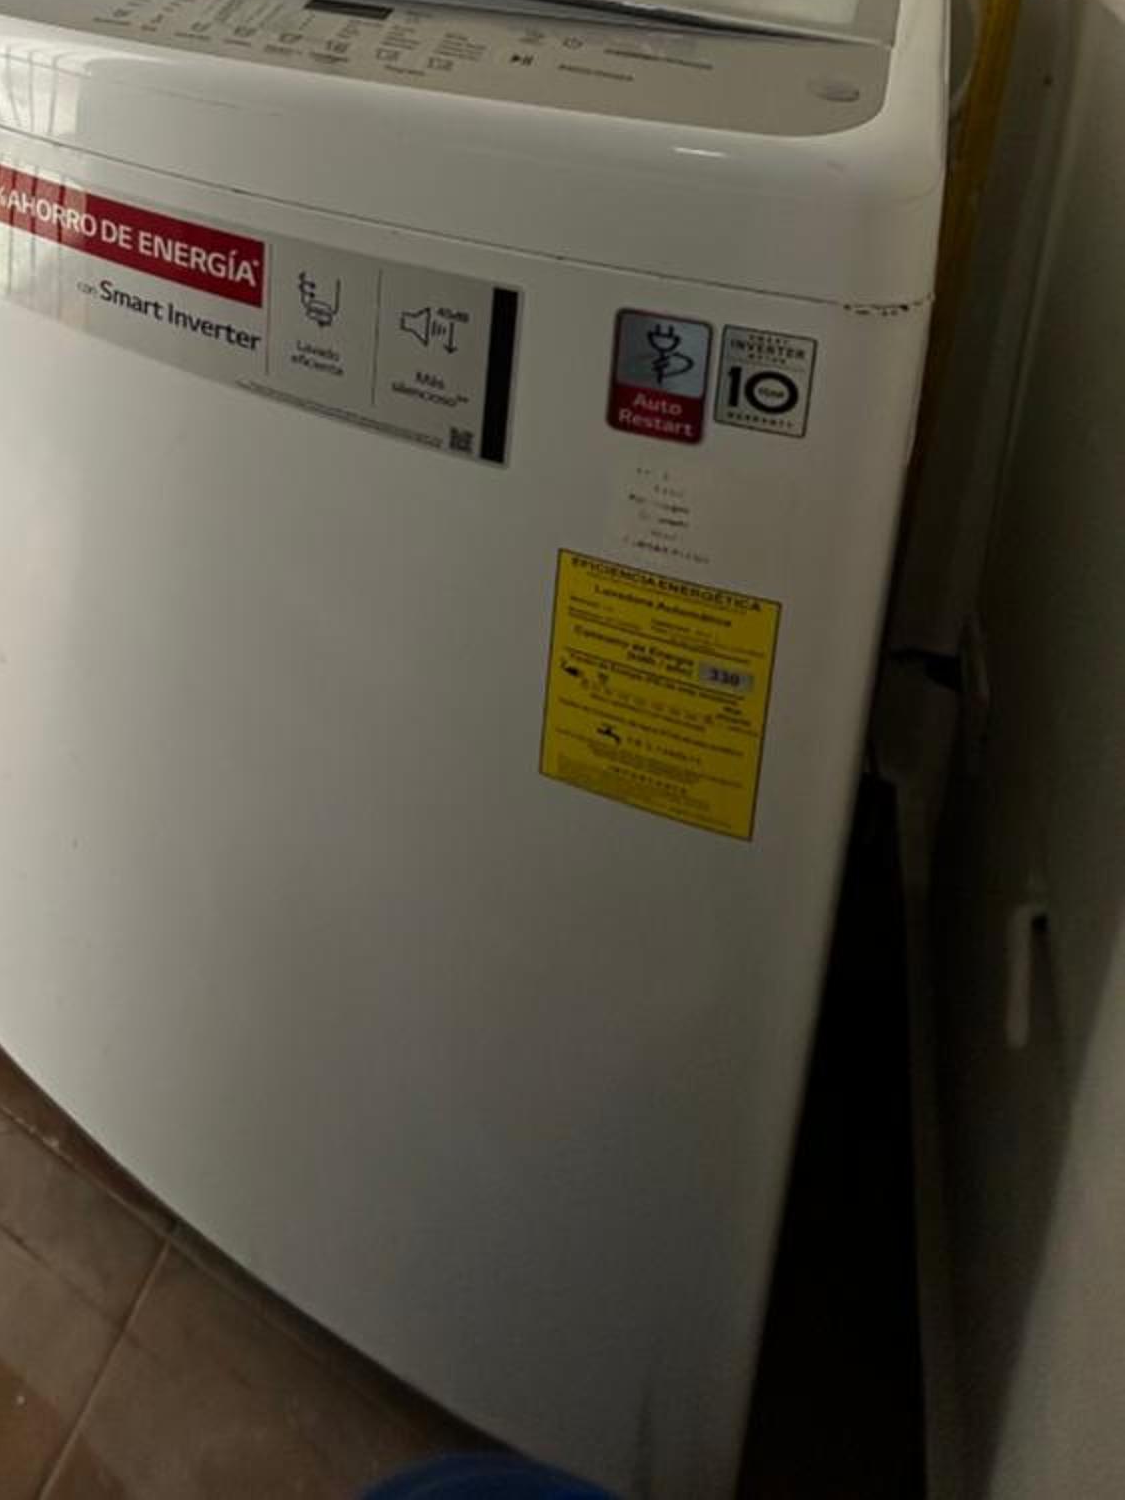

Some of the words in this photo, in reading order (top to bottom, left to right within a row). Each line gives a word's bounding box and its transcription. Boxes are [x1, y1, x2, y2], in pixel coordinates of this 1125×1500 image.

[7, 189, 97, 237] AHORRO
[101, 219, 133, 251] DE
[99, 279, 164, 320] Smart
[167, 302, 262, 351] Inverter
[632, 392, 683, 417] Auto
[727, 366, 799, 414] 10
[618, 407, 693, 437] Restart
